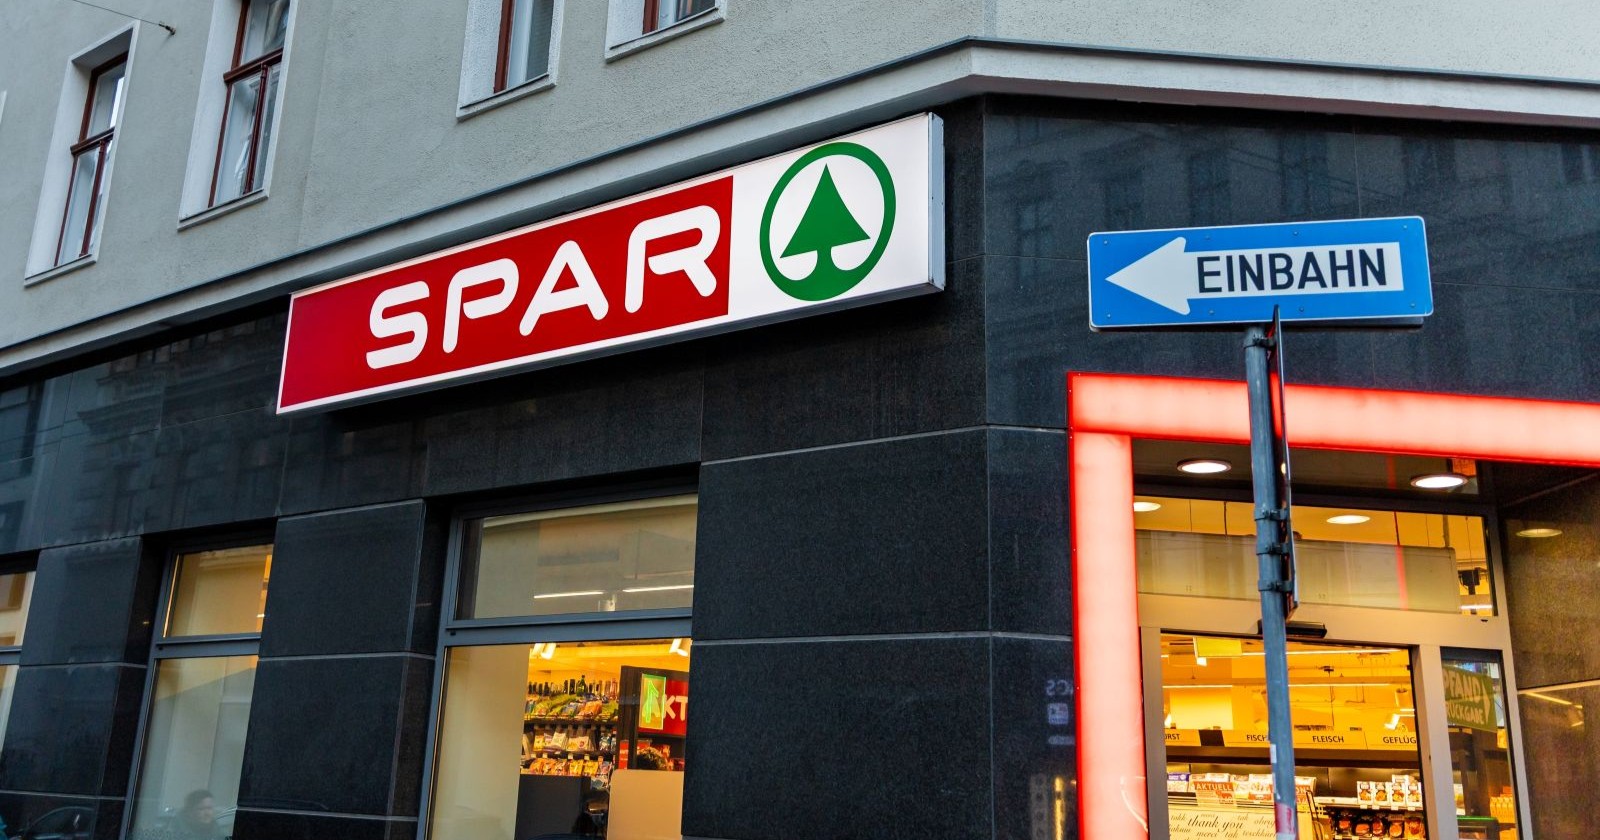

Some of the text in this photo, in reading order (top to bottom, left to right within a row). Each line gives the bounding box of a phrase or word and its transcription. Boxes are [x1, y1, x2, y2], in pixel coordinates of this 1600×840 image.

[1197, 248, 1387, 294] EINBAHN
[365, 205, 721, 369] SPAR
[1312, 735, 1345, 743] FLEISCH
[1196, 782, 1233, 791] AKTUELL
[1187, 815, 1219, 828] thank
[1217, 821, 1244, 832] you
